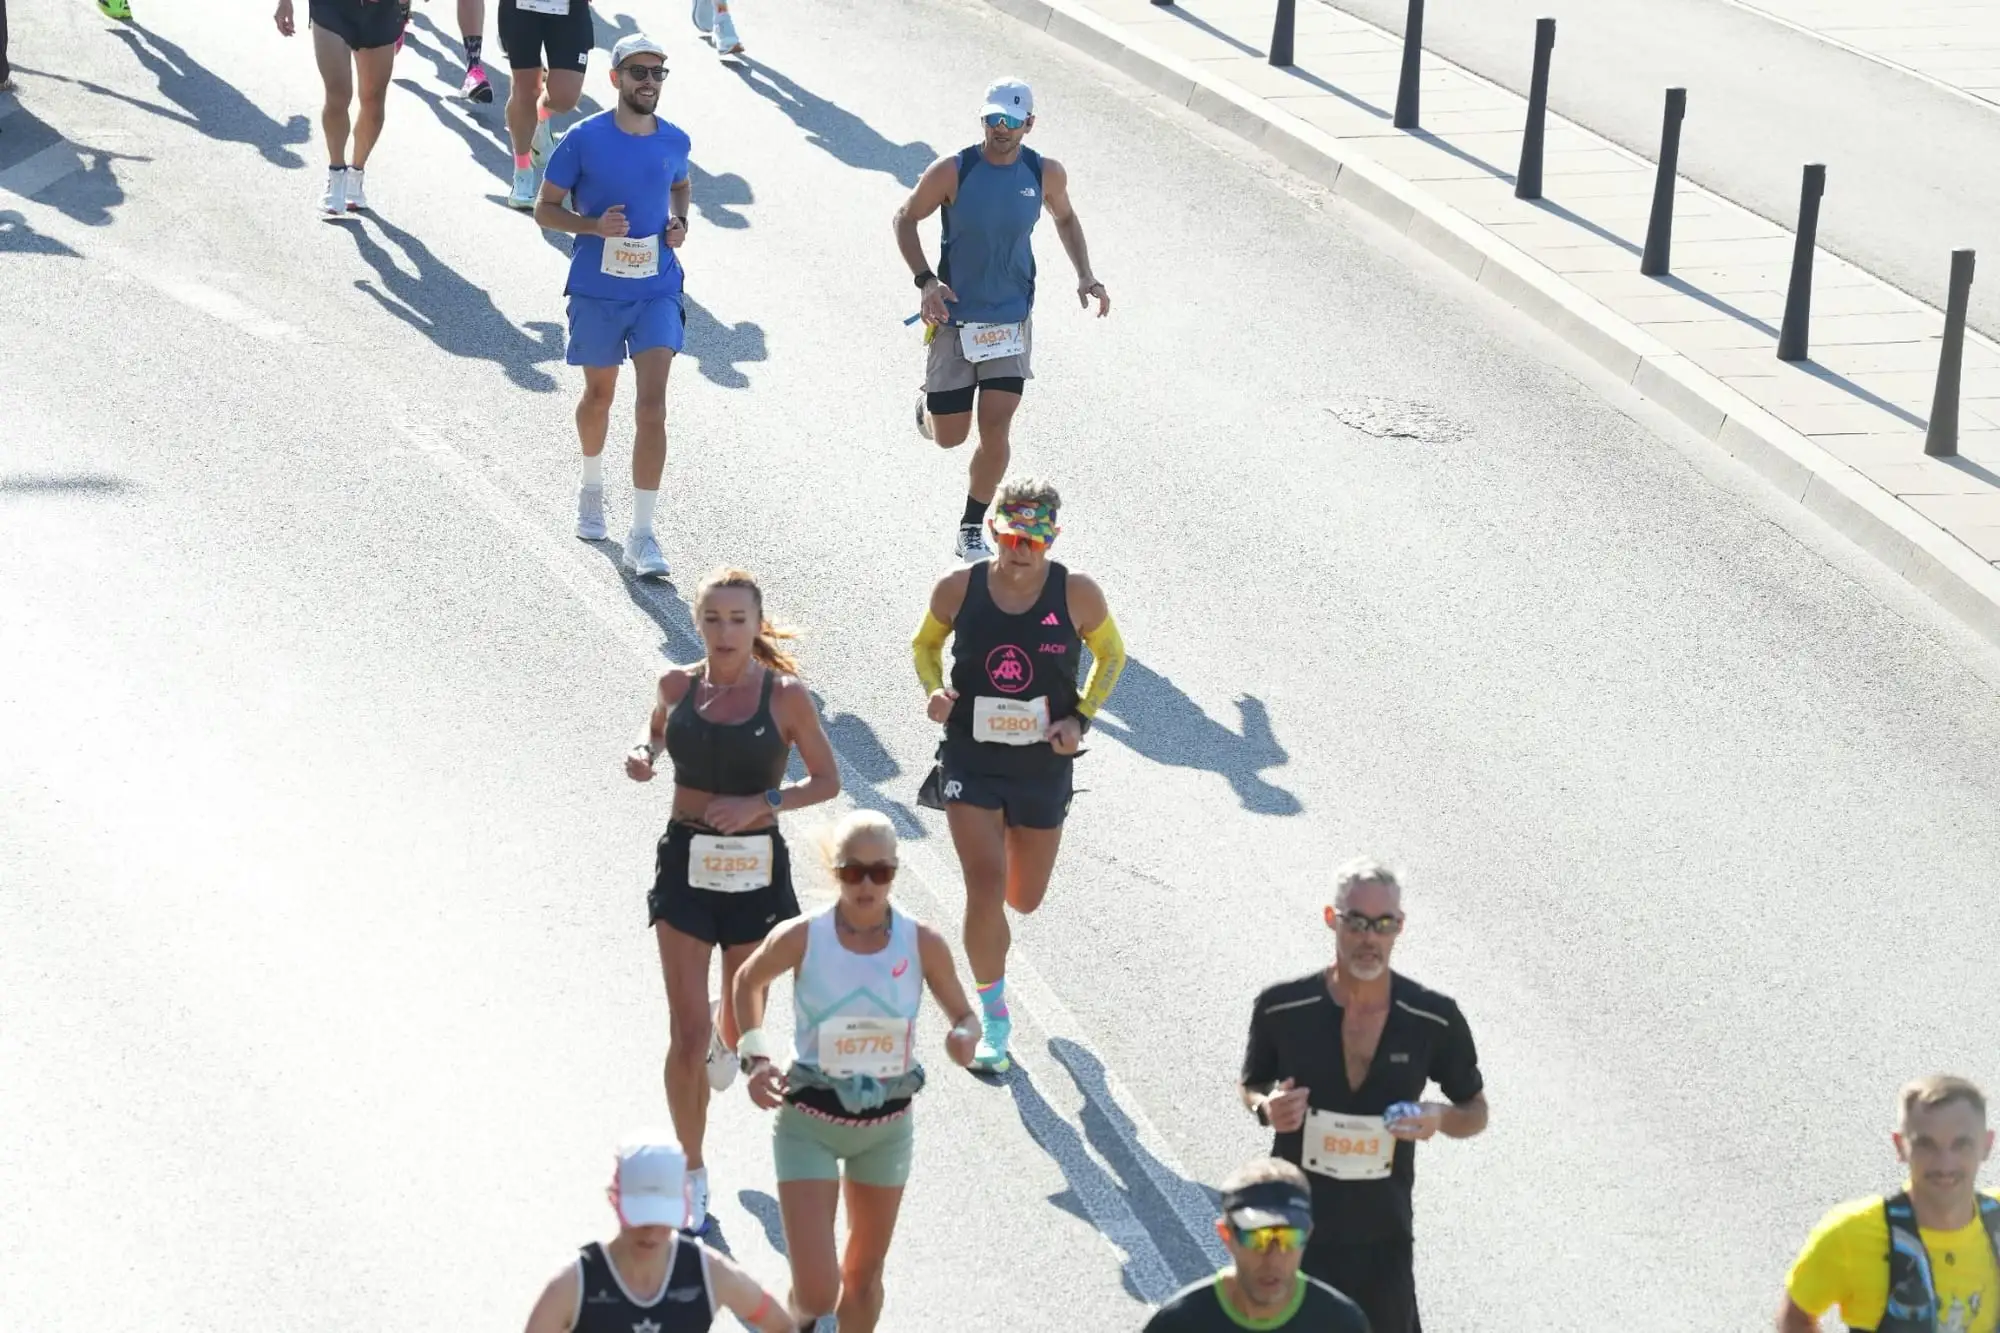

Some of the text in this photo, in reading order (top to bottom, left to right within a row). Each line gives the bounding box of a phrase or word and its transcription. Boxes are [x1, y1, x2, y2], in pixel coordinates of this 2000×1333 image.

[615, 249, 652, 264] 17033
[972, 327, 1012, 344] 14821
[987, 715, 1038, 731] 12801
[703, 855, 758, 872] 12352
[834, 1034, 894, 1055] 16776
[1324, 1134, 1379, 1155] 8943
